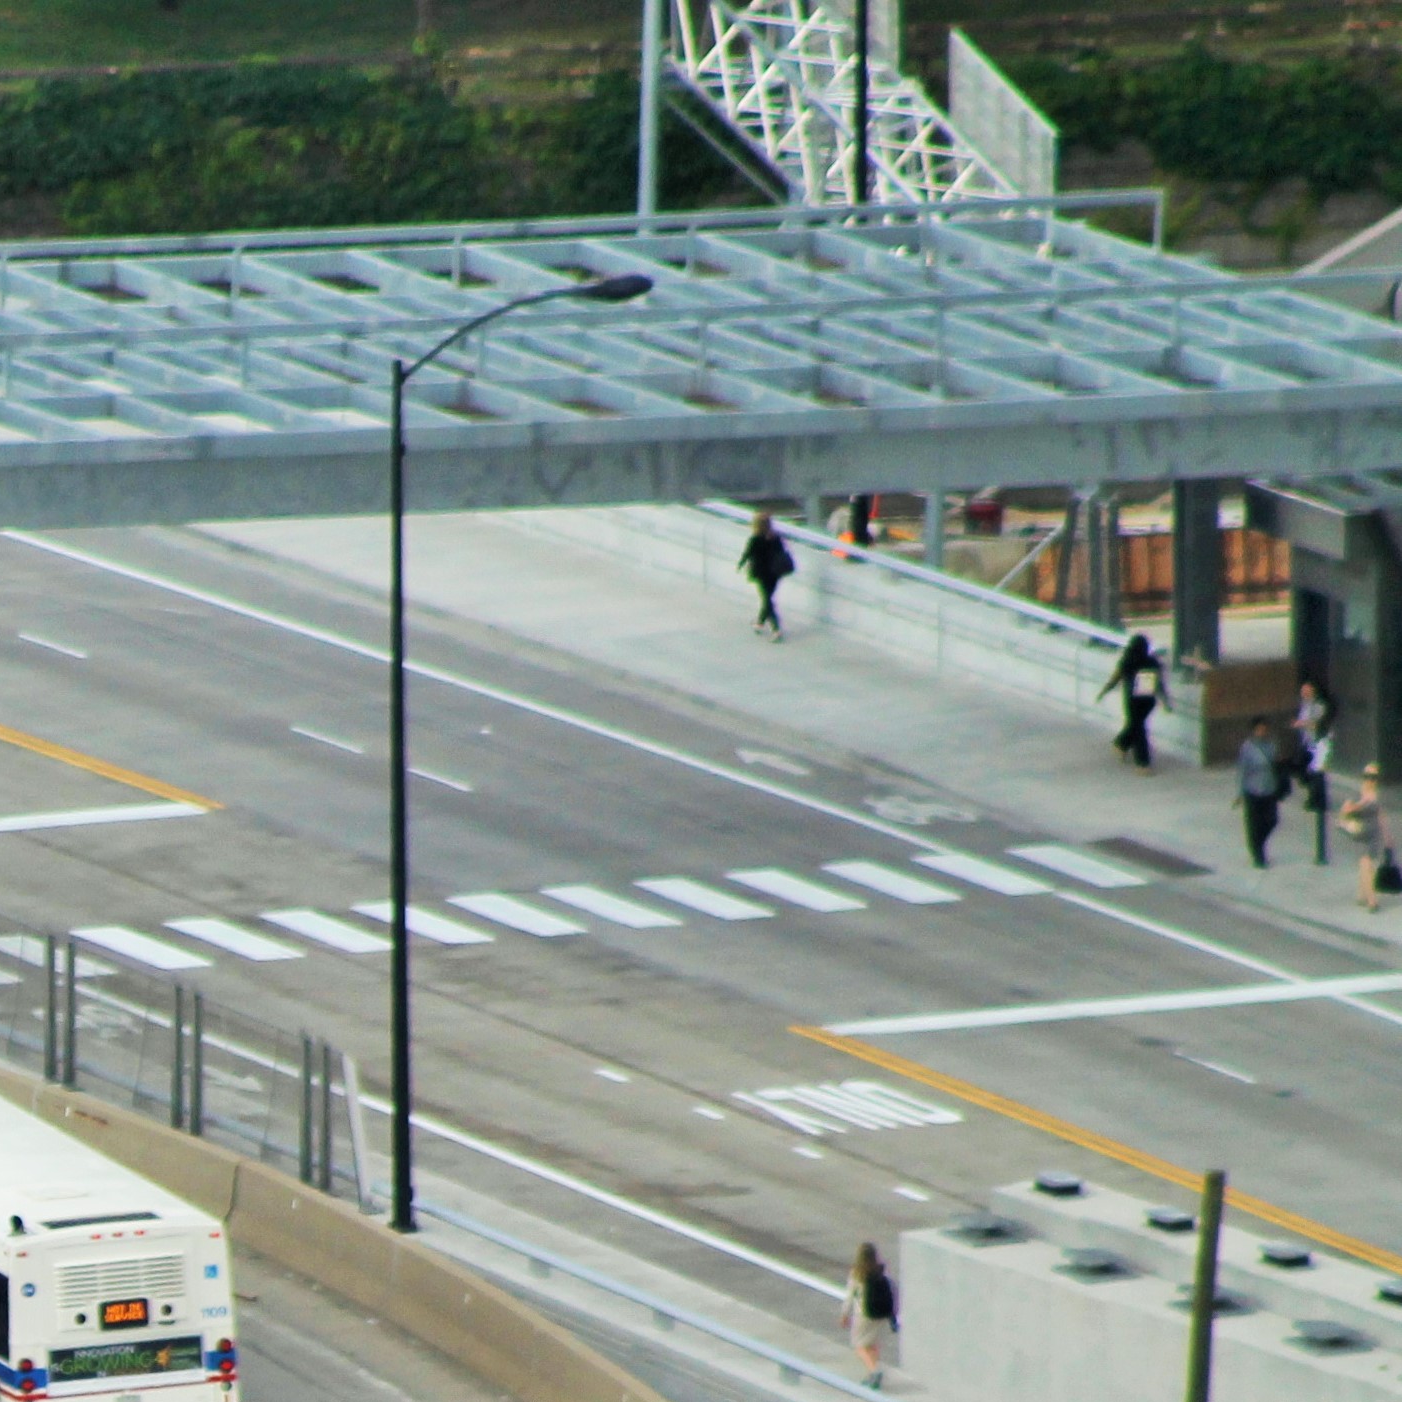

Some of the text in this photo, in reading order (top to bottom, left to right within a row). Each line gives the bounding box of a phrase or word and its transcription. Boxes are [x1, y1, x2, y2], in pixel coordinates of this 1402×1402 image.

[731, 1081, 963, 1136] ONLY
[201, 1306, 227, 1319] 1109
[74, 1345, 135, 1358] INNOVATION
[60, 1351, 152, 1375] GROWING
